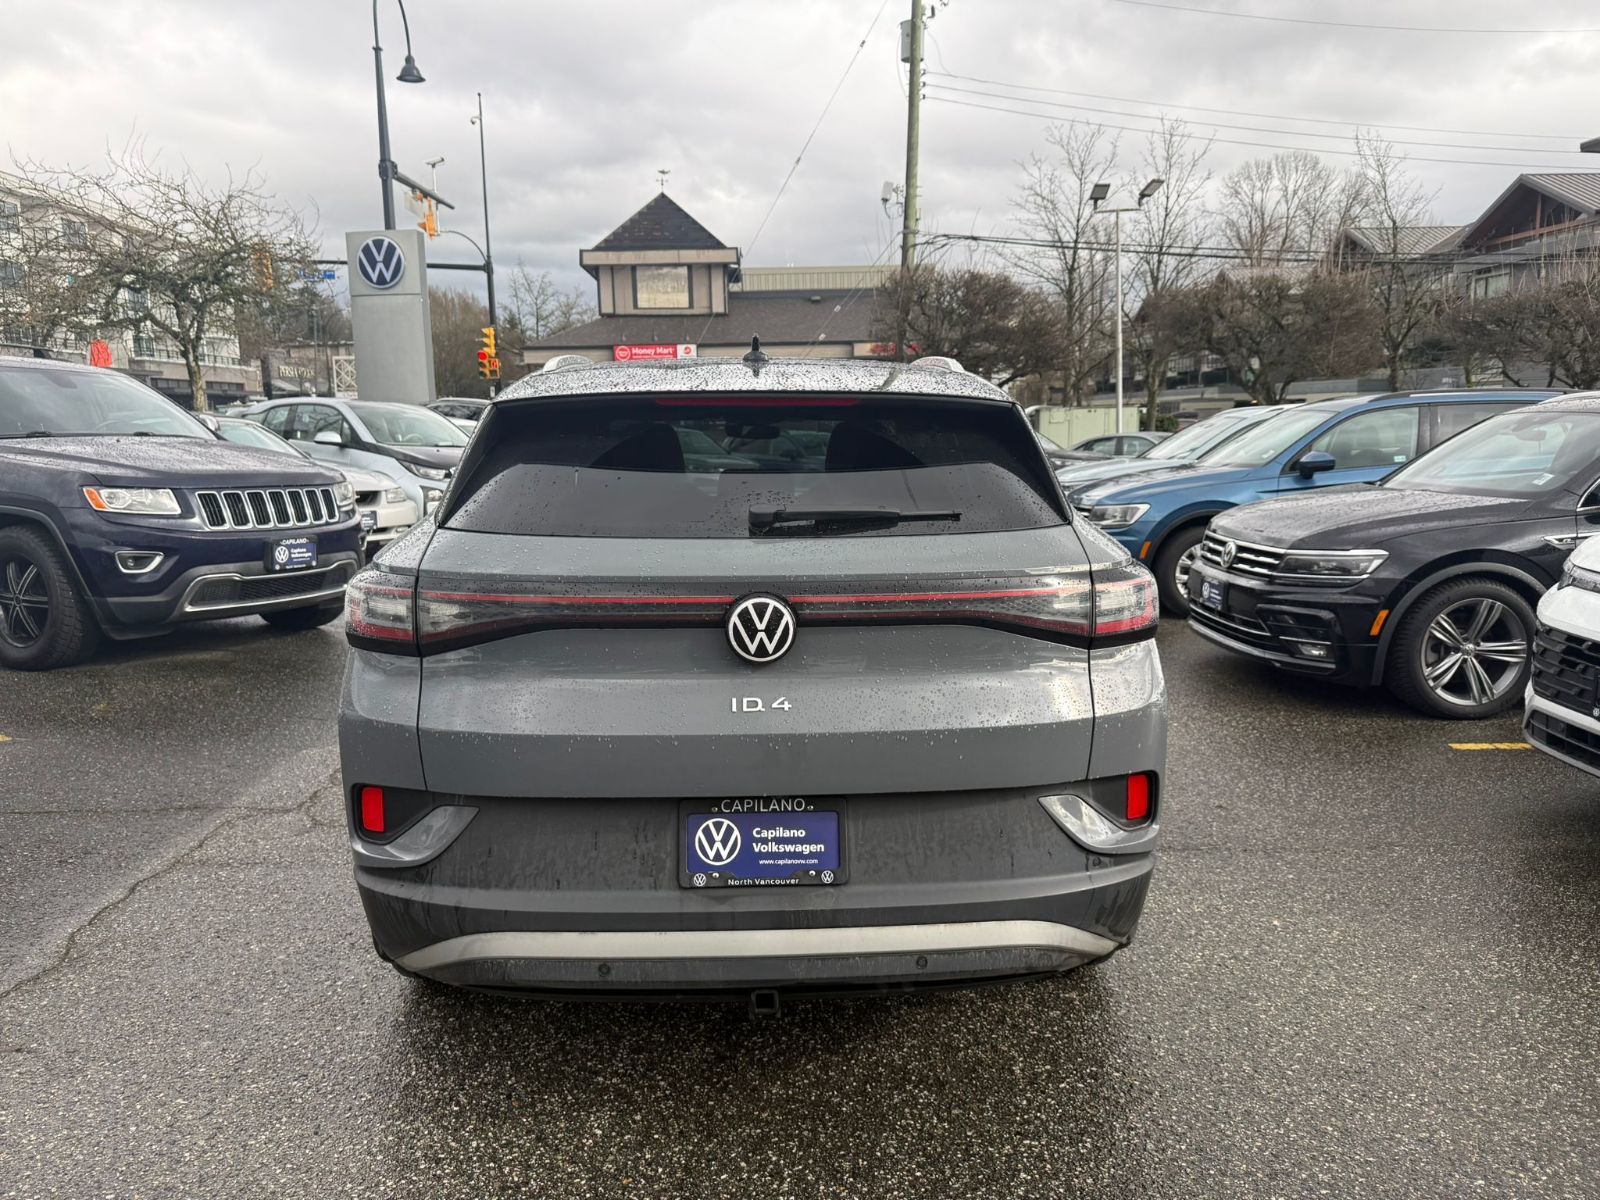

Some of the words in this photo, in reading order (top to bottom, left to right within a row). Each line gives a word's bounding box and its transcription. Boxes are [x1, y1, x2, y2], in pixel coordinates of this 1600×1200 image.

[631, 347, 655, 356] Money
[728, 597, 794, 662] VW
[721, 798, 806, 813] CAPILANO
[752, 827, 806, 840] Capilano
[752, 842, 825, 855] Volkswagen
[759, 858, 819, 866] www.capilanovw.com
[728, 878, 753, 886] North
[754, 877, 800, 885] Vancouver
